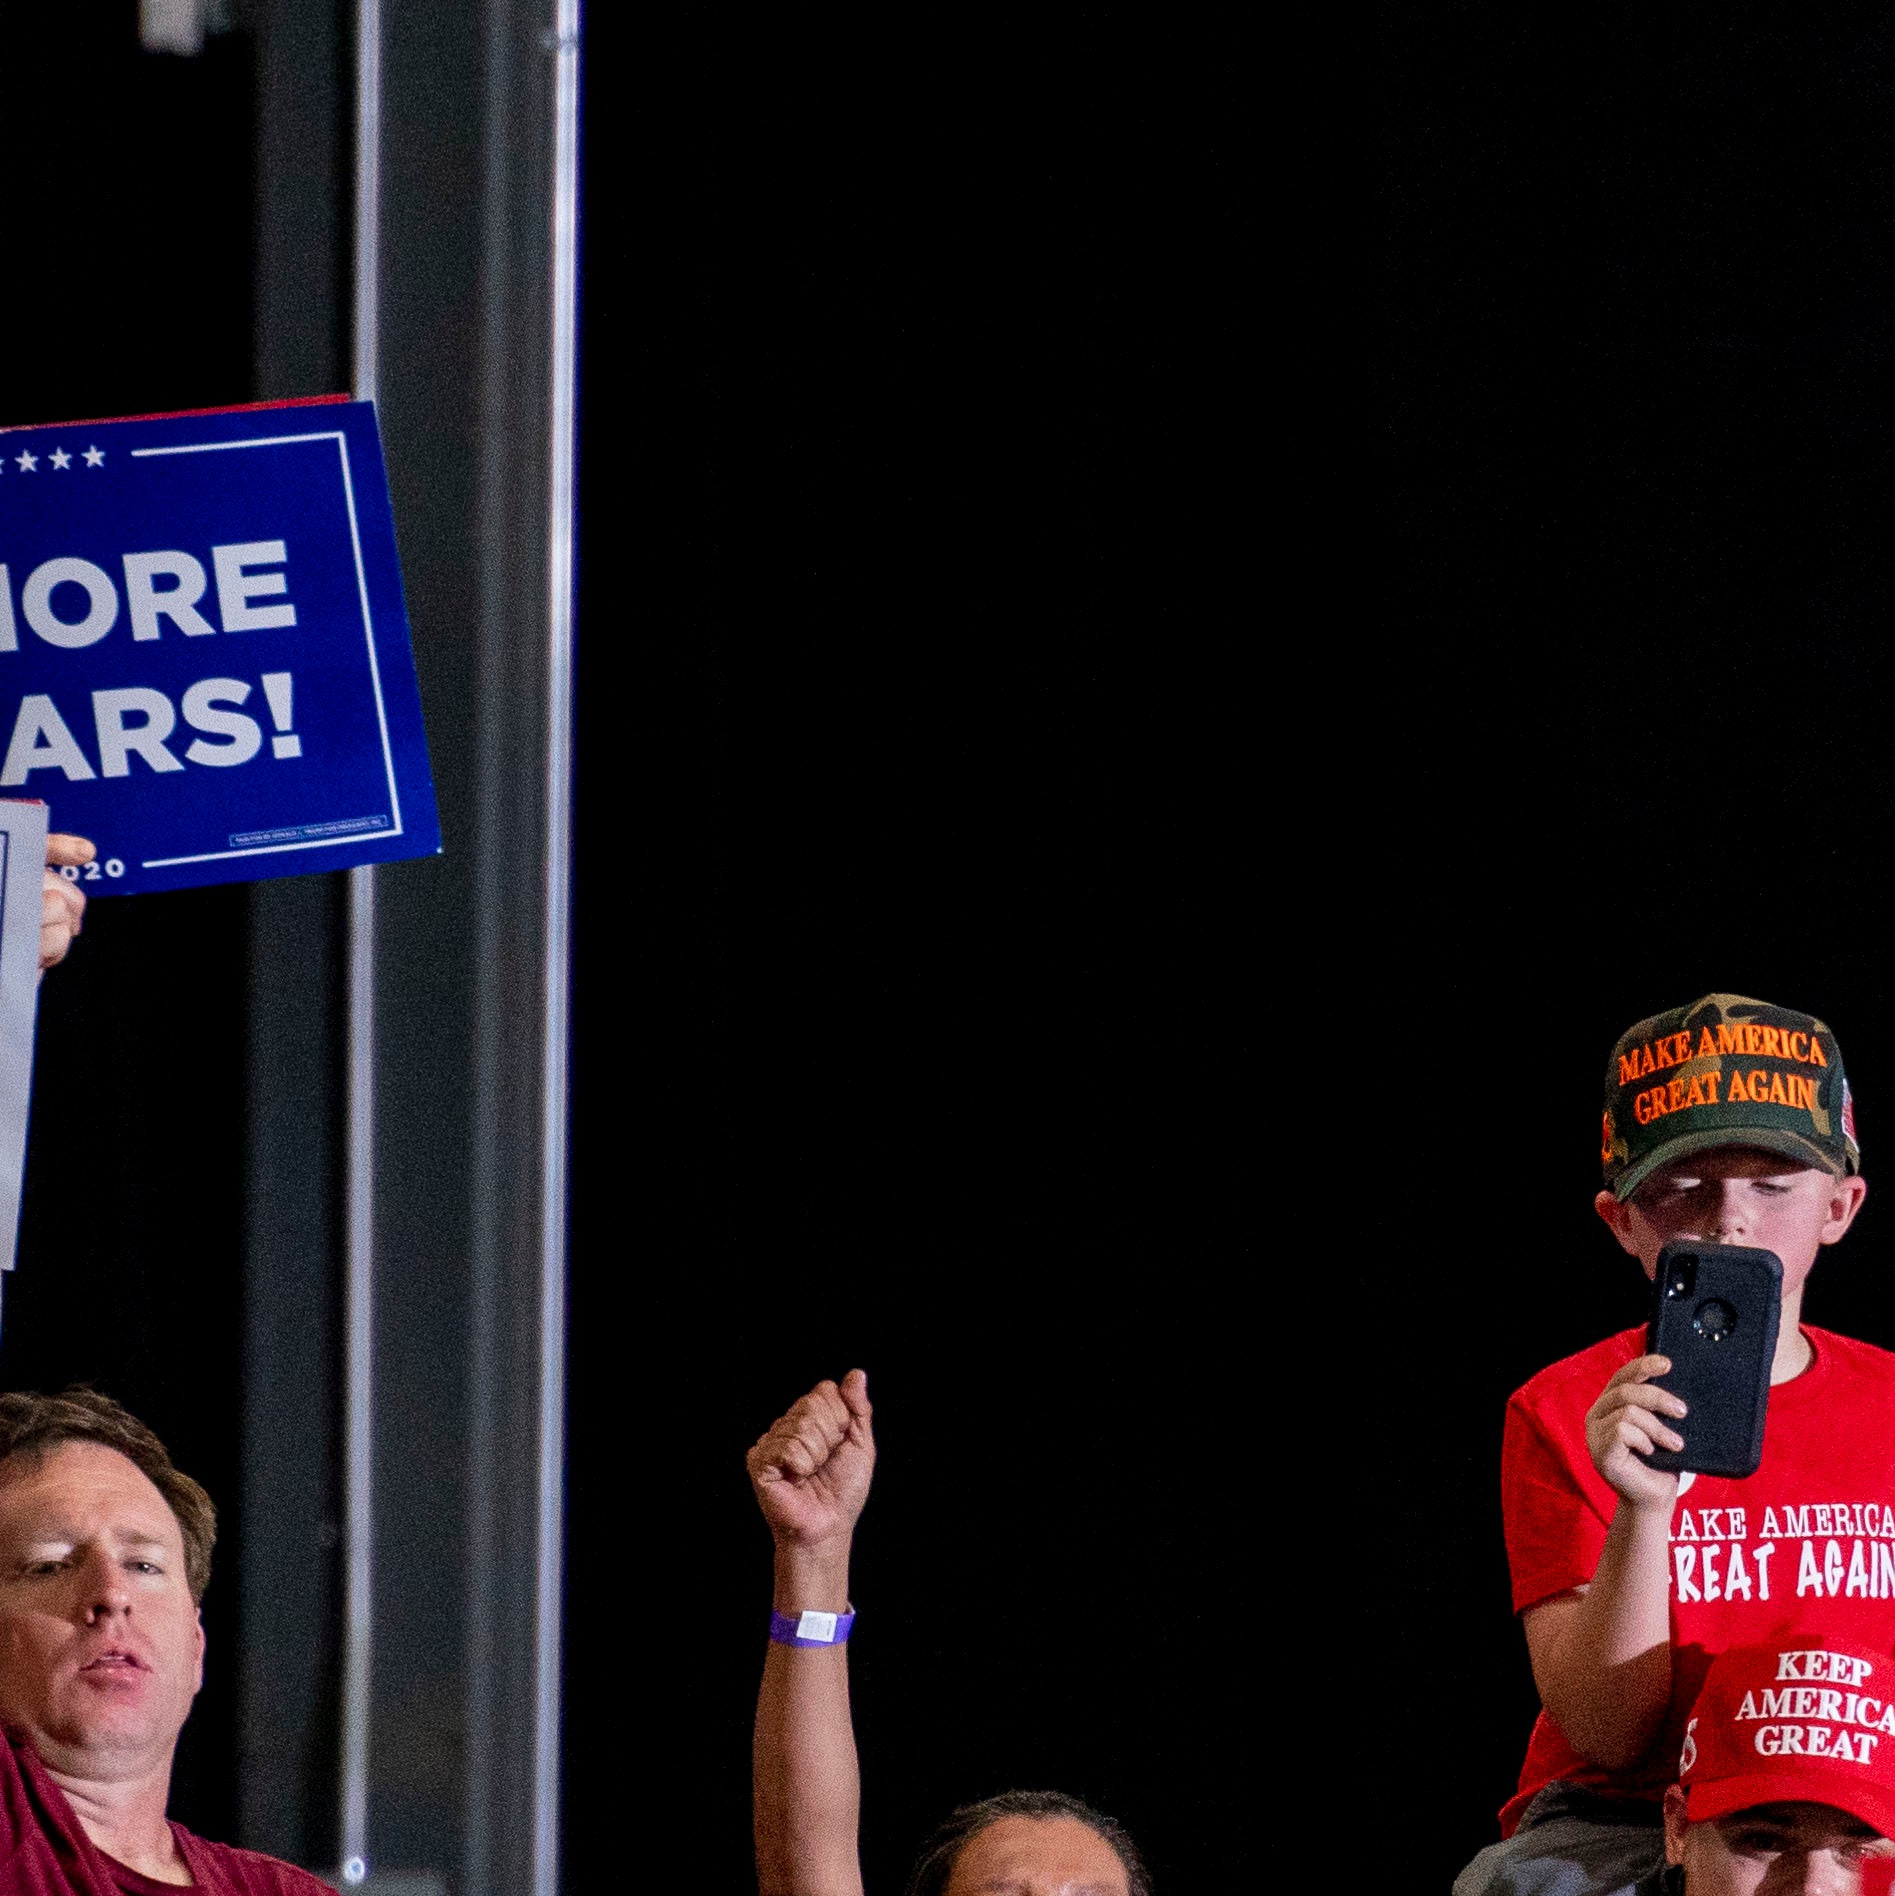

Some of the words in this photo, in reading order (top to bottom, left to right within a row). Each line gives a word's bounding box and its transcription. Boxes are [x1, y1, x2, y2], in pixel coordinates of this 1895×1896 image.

[1618, 1030, 1694, 1087] MAKE
[1697, 1023, 1828, 1068] AMERICA
[1633, 1070, 1722, 1126] GREAT
[1727, 1069, 1817, 1111] AGAIN
[1668, 1507, 1747, 1542] AKE
[1669, 1541, 1776, 1603] REAT
[1775, 1650, 1873, 1688] KEEP
[1754, 1724, 1879, 1765] GREAT
